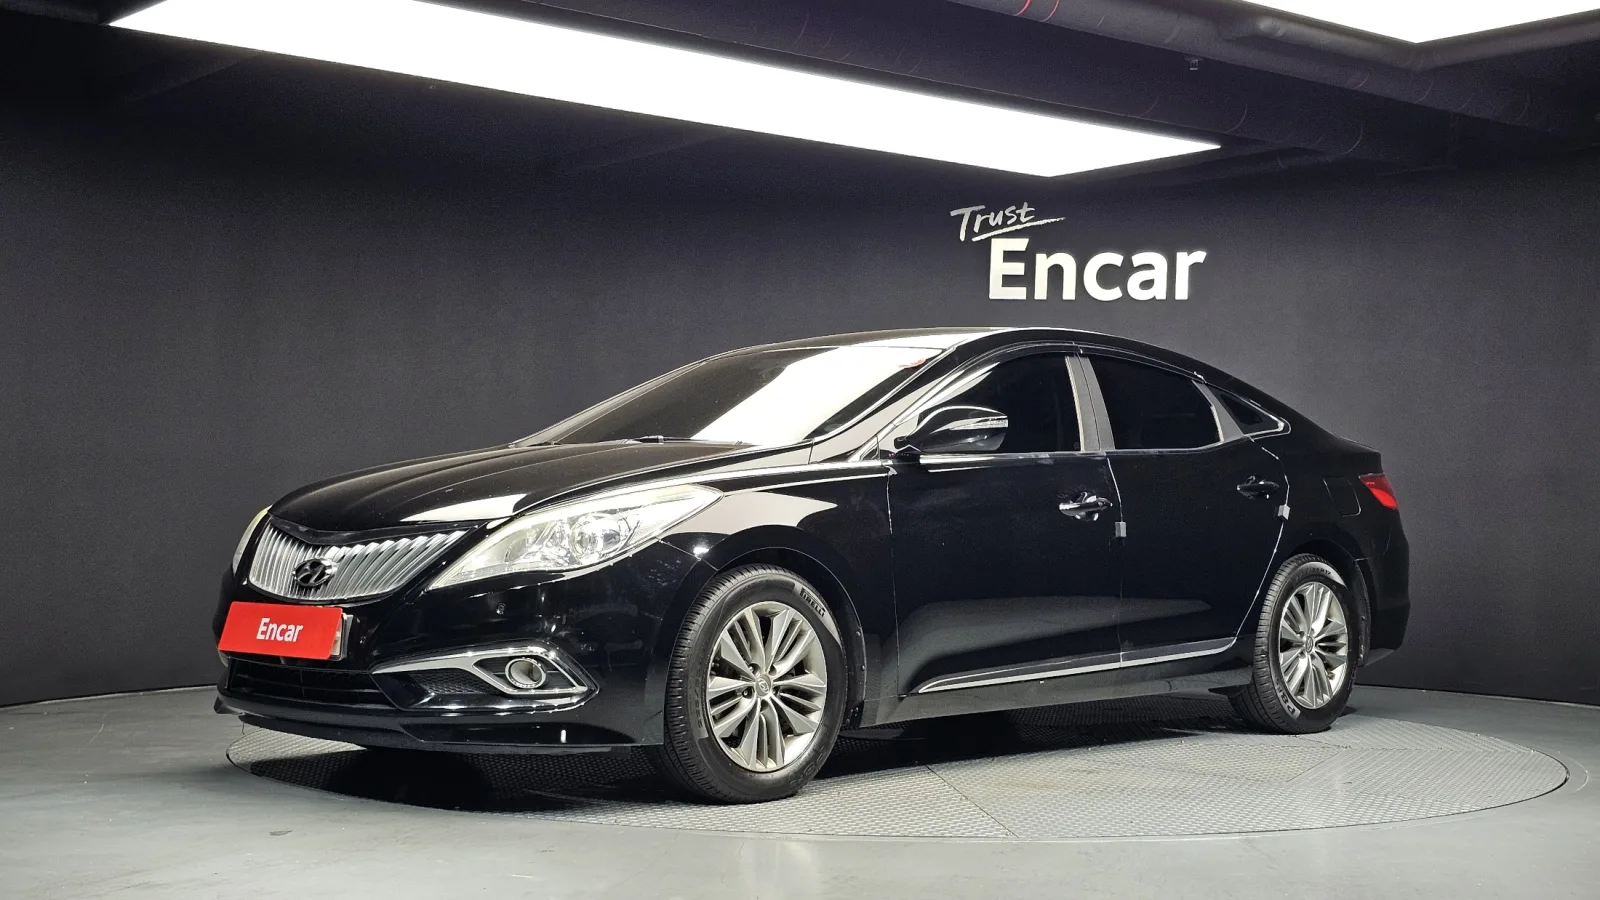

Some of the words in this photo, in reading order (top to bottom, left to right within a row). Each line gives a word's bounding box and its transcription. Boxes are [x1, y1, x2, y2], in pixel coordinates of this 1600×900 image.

[950, 202, 1035, 241] Trust
[989, 238, 1207, 301] Encar
[799, 587, 826, 618] PIRELLI
[256, 617, 304, 642] Encar
